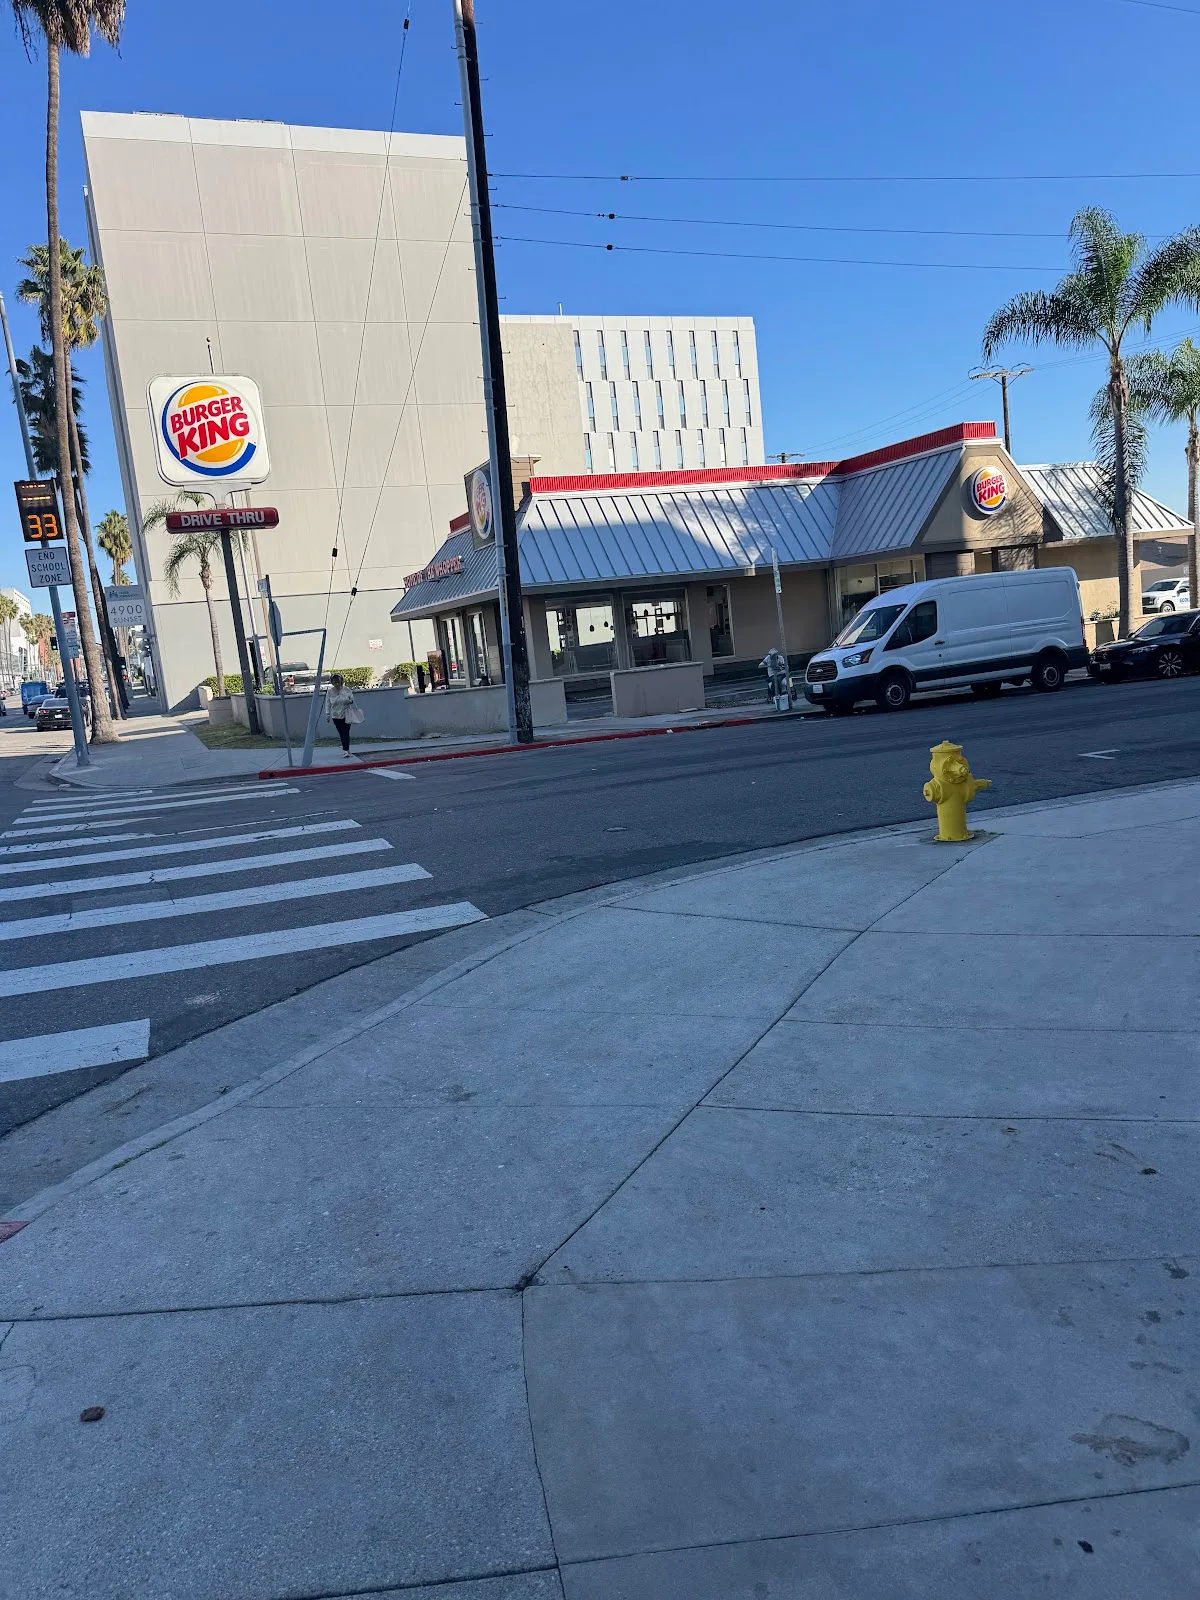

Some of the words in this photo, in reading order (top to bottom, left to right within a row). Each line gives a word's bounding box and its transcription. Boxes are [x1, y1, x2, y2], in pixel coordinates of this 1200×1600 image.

[170, 396, 244, 434] BURGER
[177, 412, 250, 459] KING
[976, 474, 1004, 492] BURGER
[978, 482, 1005, 504] KING
[27, 513, 59, 539] 33
[180, 513, 222, 527] DRIVE
[227, 510, 265, 525] THRU
[38, 551, 55, 561] END
[31, 562, 67, 573] SCHOOL
[39, 573, 63, 584] ZONE
[110, 604, 143, 616] 4900
[113, 615, 143, 624] SUNSET
